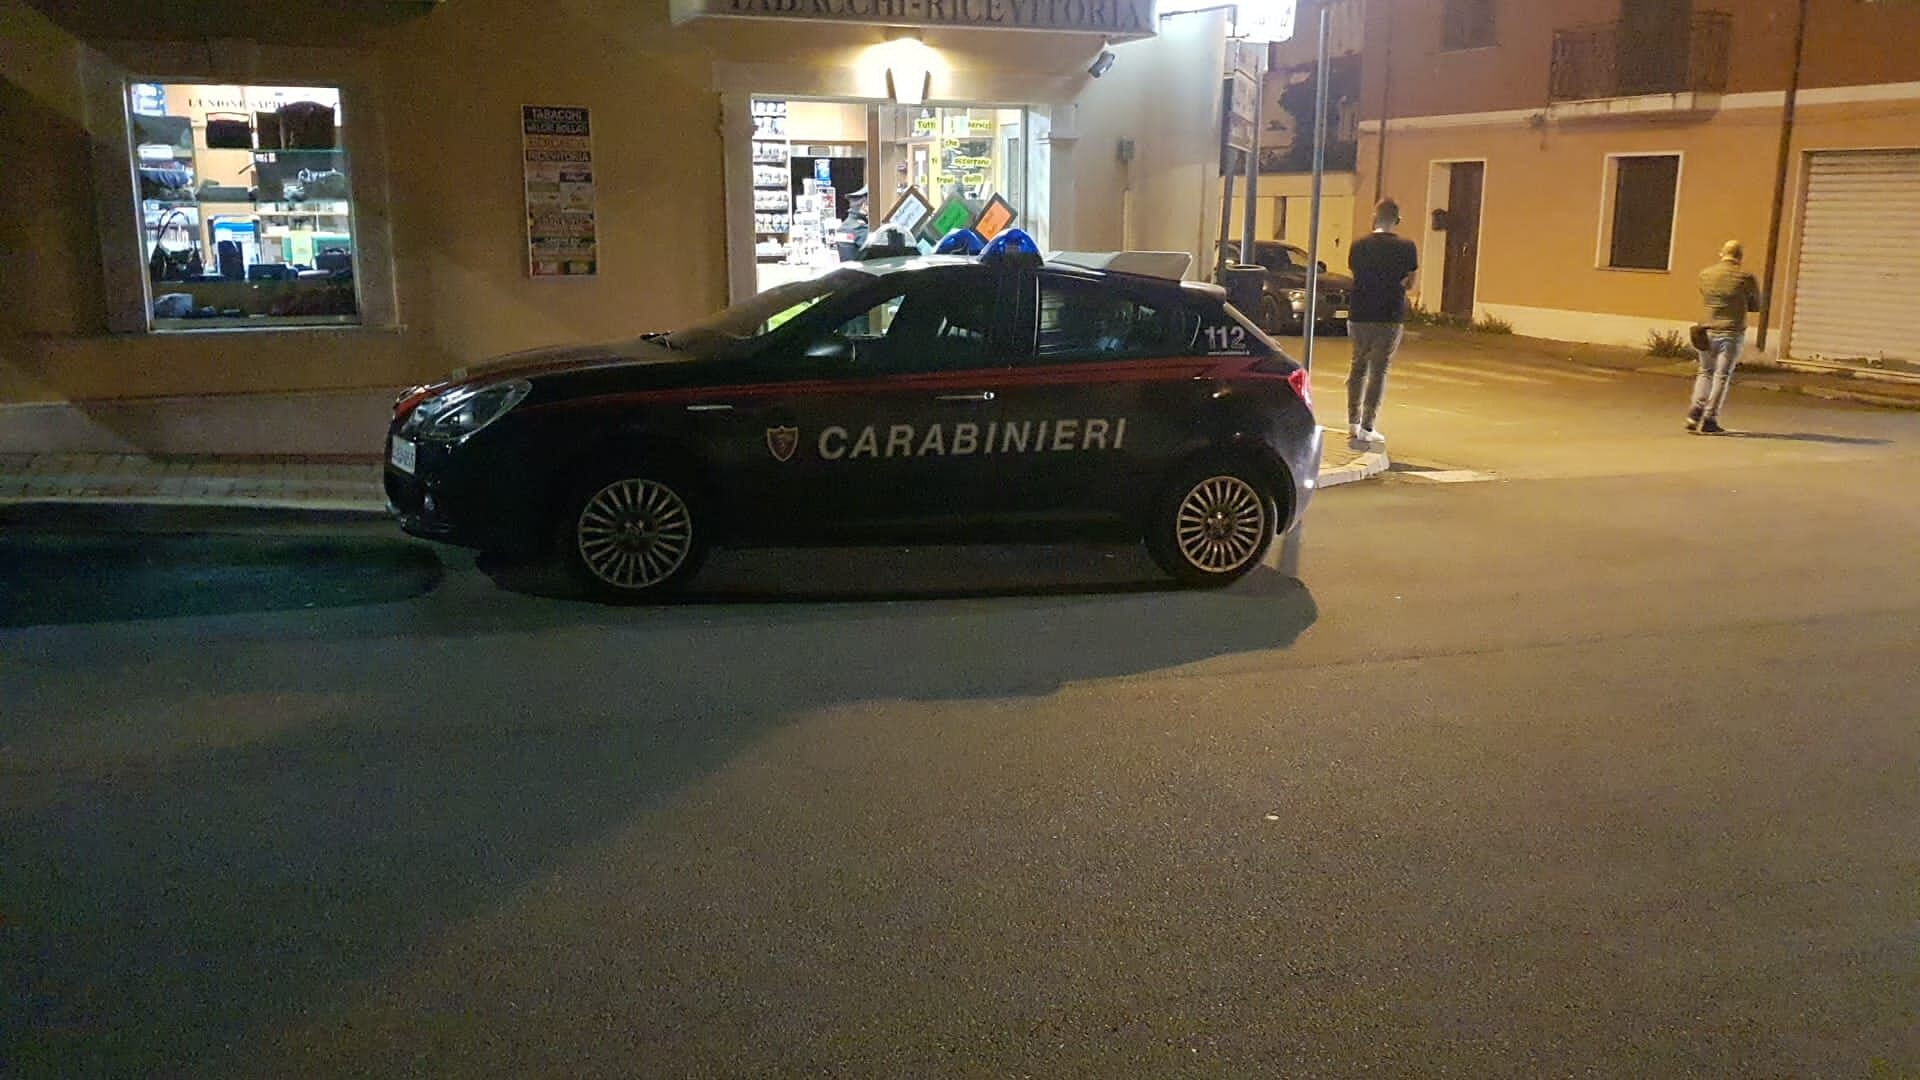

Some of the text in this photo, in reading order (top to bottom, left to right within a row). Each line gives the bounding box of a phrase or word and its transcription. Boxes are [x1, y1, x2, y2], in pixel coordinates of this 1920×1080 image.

[731, 0, 1149, 28] CCHI-RICEVITORIA
[918, 120, 937, 129] Tutti
[1204, 325, 1247, 350] 112
[817, 417, 1127, 461] CARABINIERI
